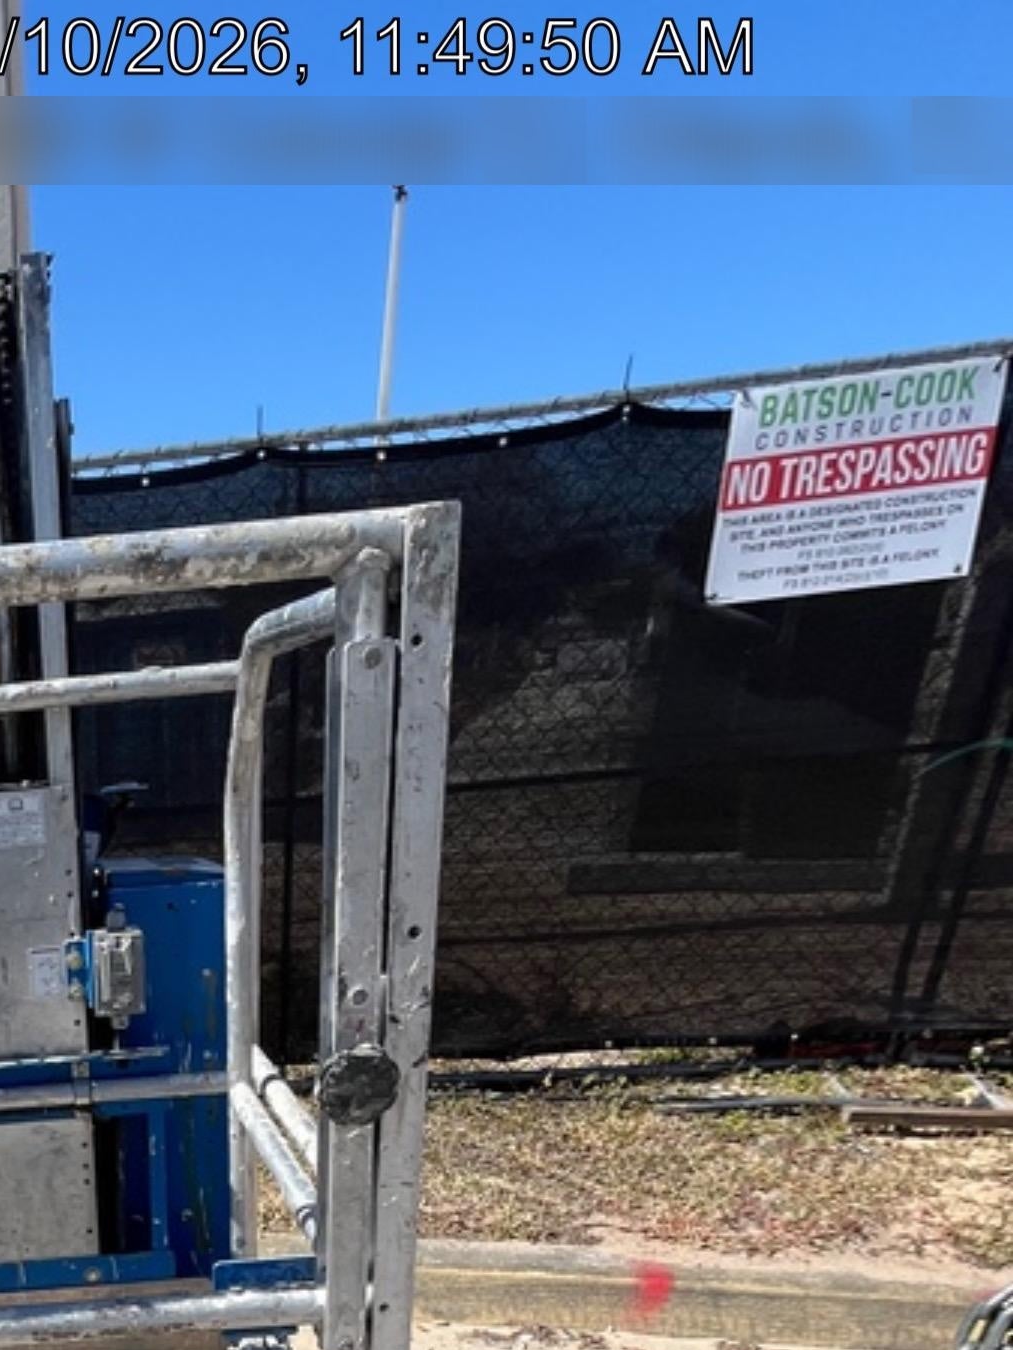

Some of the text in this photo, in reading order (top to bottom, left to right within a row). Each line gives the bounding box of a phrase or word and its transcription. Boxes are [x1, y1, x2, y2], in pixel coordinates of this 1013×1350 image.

[758, 366, 980, 428] BATSON-COOK
[755, 406, 973, 450] CONSTRUCTION
[727, 434, 988, 506] NO TRESPASSING
[752, 511, 782, 523] AREA
[810, 499, 881, 516] DESIGNATED
[884, 488, 977, 507] CONSTRUCTION
[869, 505, 943, 522] TRESPASSES
[769, 535, 830, 549] PROPERTY
